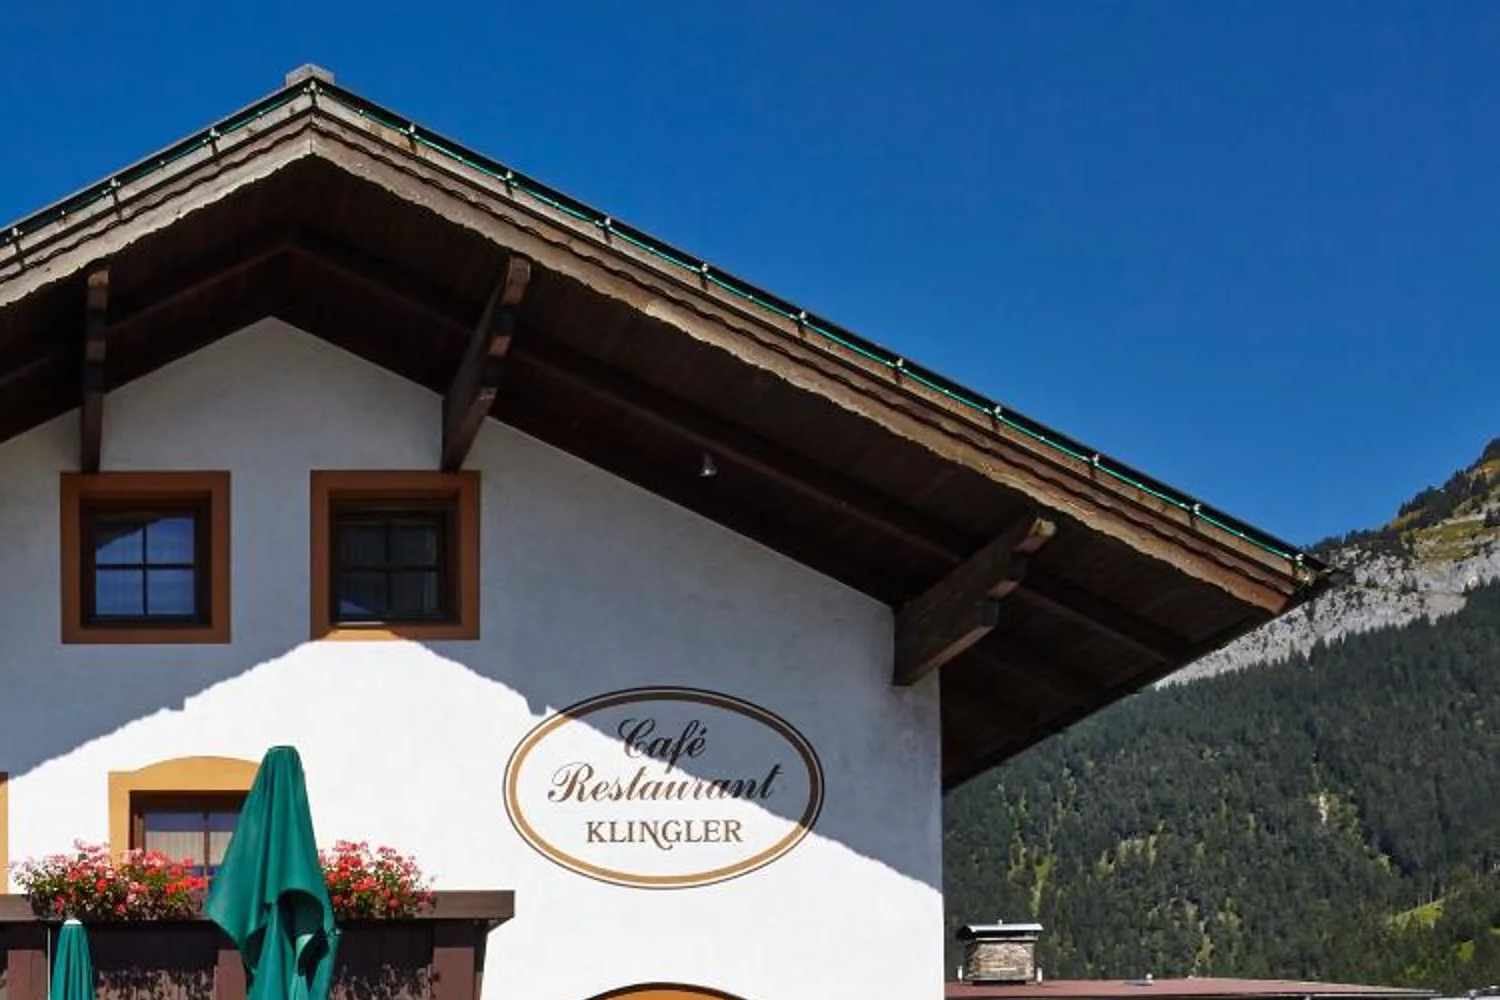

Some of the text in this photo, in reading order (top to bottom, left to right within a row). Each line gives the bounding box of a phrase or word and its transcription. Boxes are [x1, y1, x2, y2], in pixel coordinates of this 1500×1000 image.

[617, 718, 708, 774] Café
[547, 761, 784, 803] Restaurant
[586, 819, 744, 850] KLINGLER
